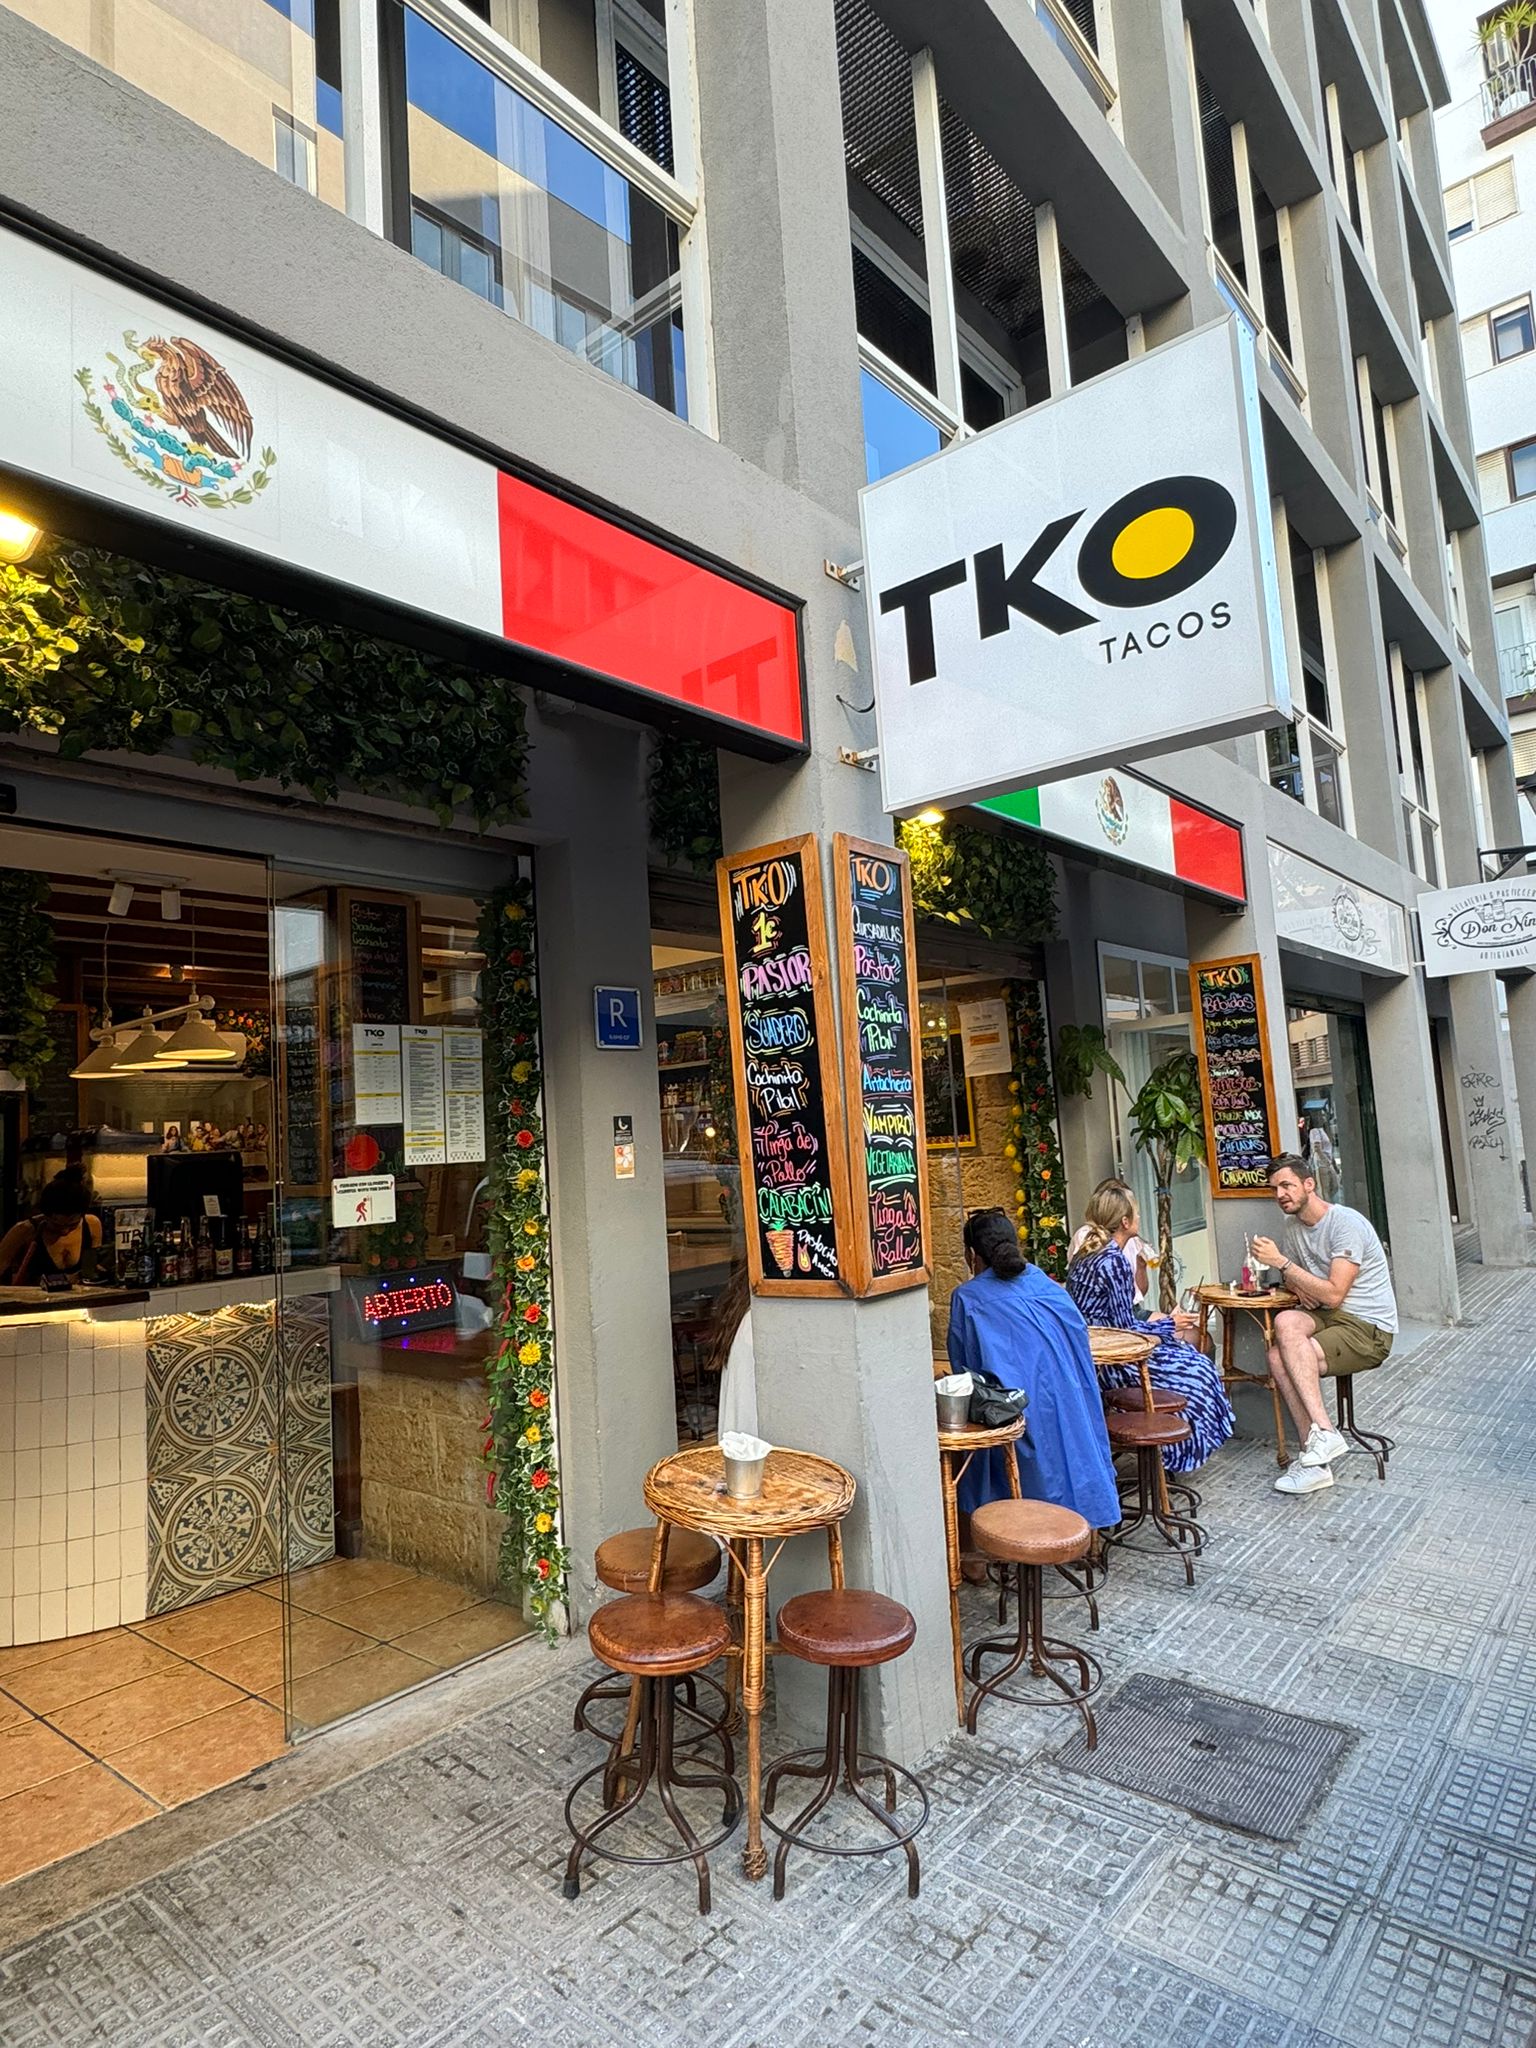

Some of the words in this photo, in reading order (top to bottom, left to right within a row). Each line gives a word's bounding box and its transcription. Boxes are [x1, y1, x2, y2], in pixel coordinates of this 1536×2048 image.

[879, 475, 1237, 686] TKO
[1099, 602, 1231, 663] TACOS
[733, 861, 786, 910] TKO
[852, 858, 890, 891] TKO
[1461, 920, 1497, 940] Don
[743, 952, 812, 1001] PASTOR
[854, 945, 897, 981] Pastor
[1204, 967, 1242, 987] TKO
[609, 998, 628, 1028] R
[856, 988, 903, 1024] Cochinita
[364, 1028, 385, 1037] TKO
[747, 1012, 806, 1048] SUADERO
[747, 1062, 802, 1086] Cochinita
[760, 1087, 801, 1113] Pibil
[864, 1106, 912, 1137] VAMPIRO
[757, 1124, 793, 1161] Tinga
[796, 1127, 812, 1150] de
[865, 1148, 917, 1177] VEGETARIANA
[364, 1283, 452, 1321] ABIERTO
